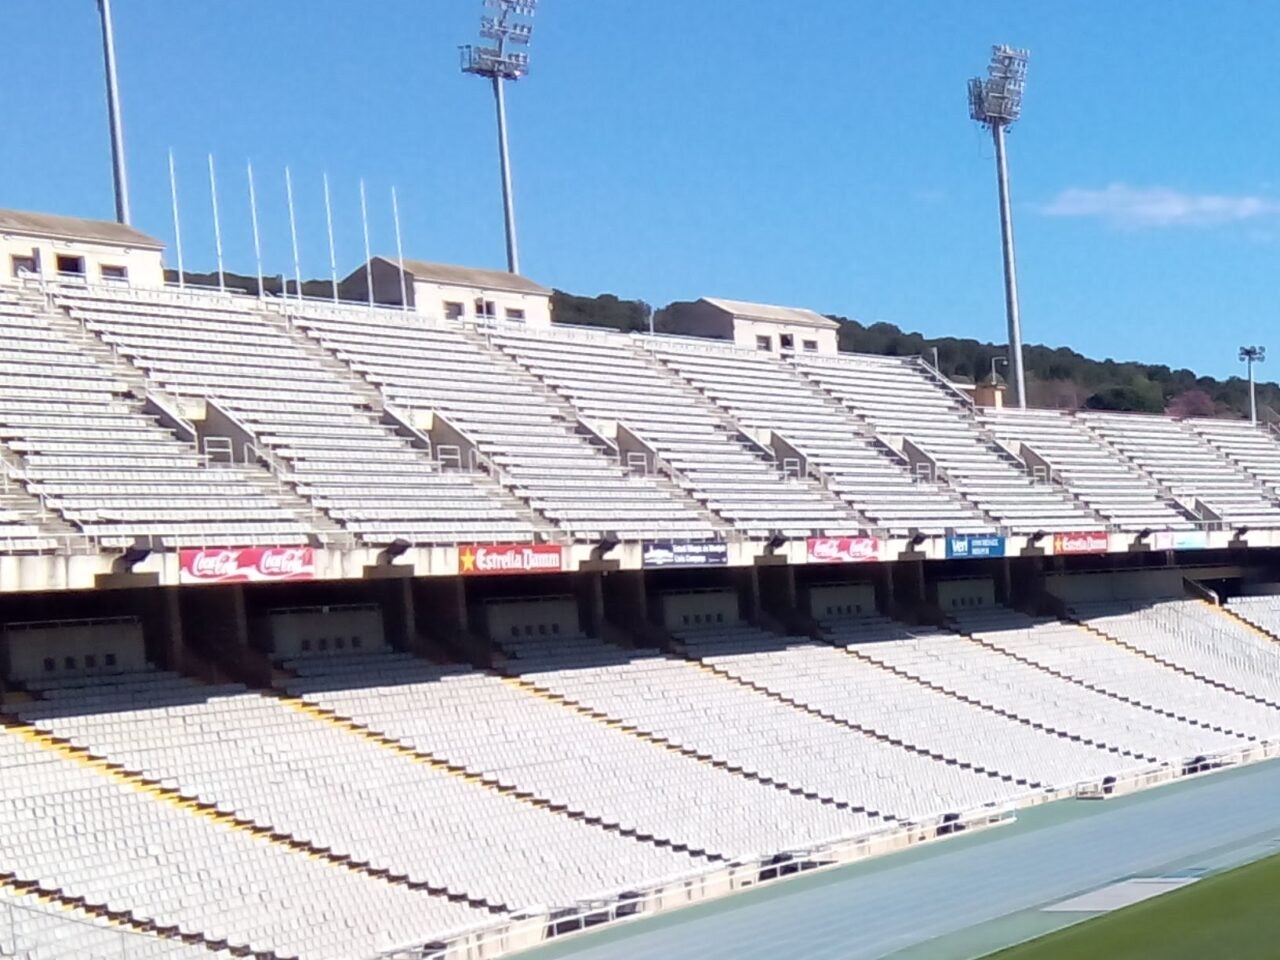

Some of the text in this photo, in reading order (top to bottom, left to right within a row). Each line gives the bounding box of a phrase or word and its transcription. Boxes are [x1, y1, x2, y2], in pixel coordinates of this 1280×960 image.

[192, 549, 306, 577] Coca-Cola Coca-Cola
[476, 548, 560, 570] Estrella Damm
